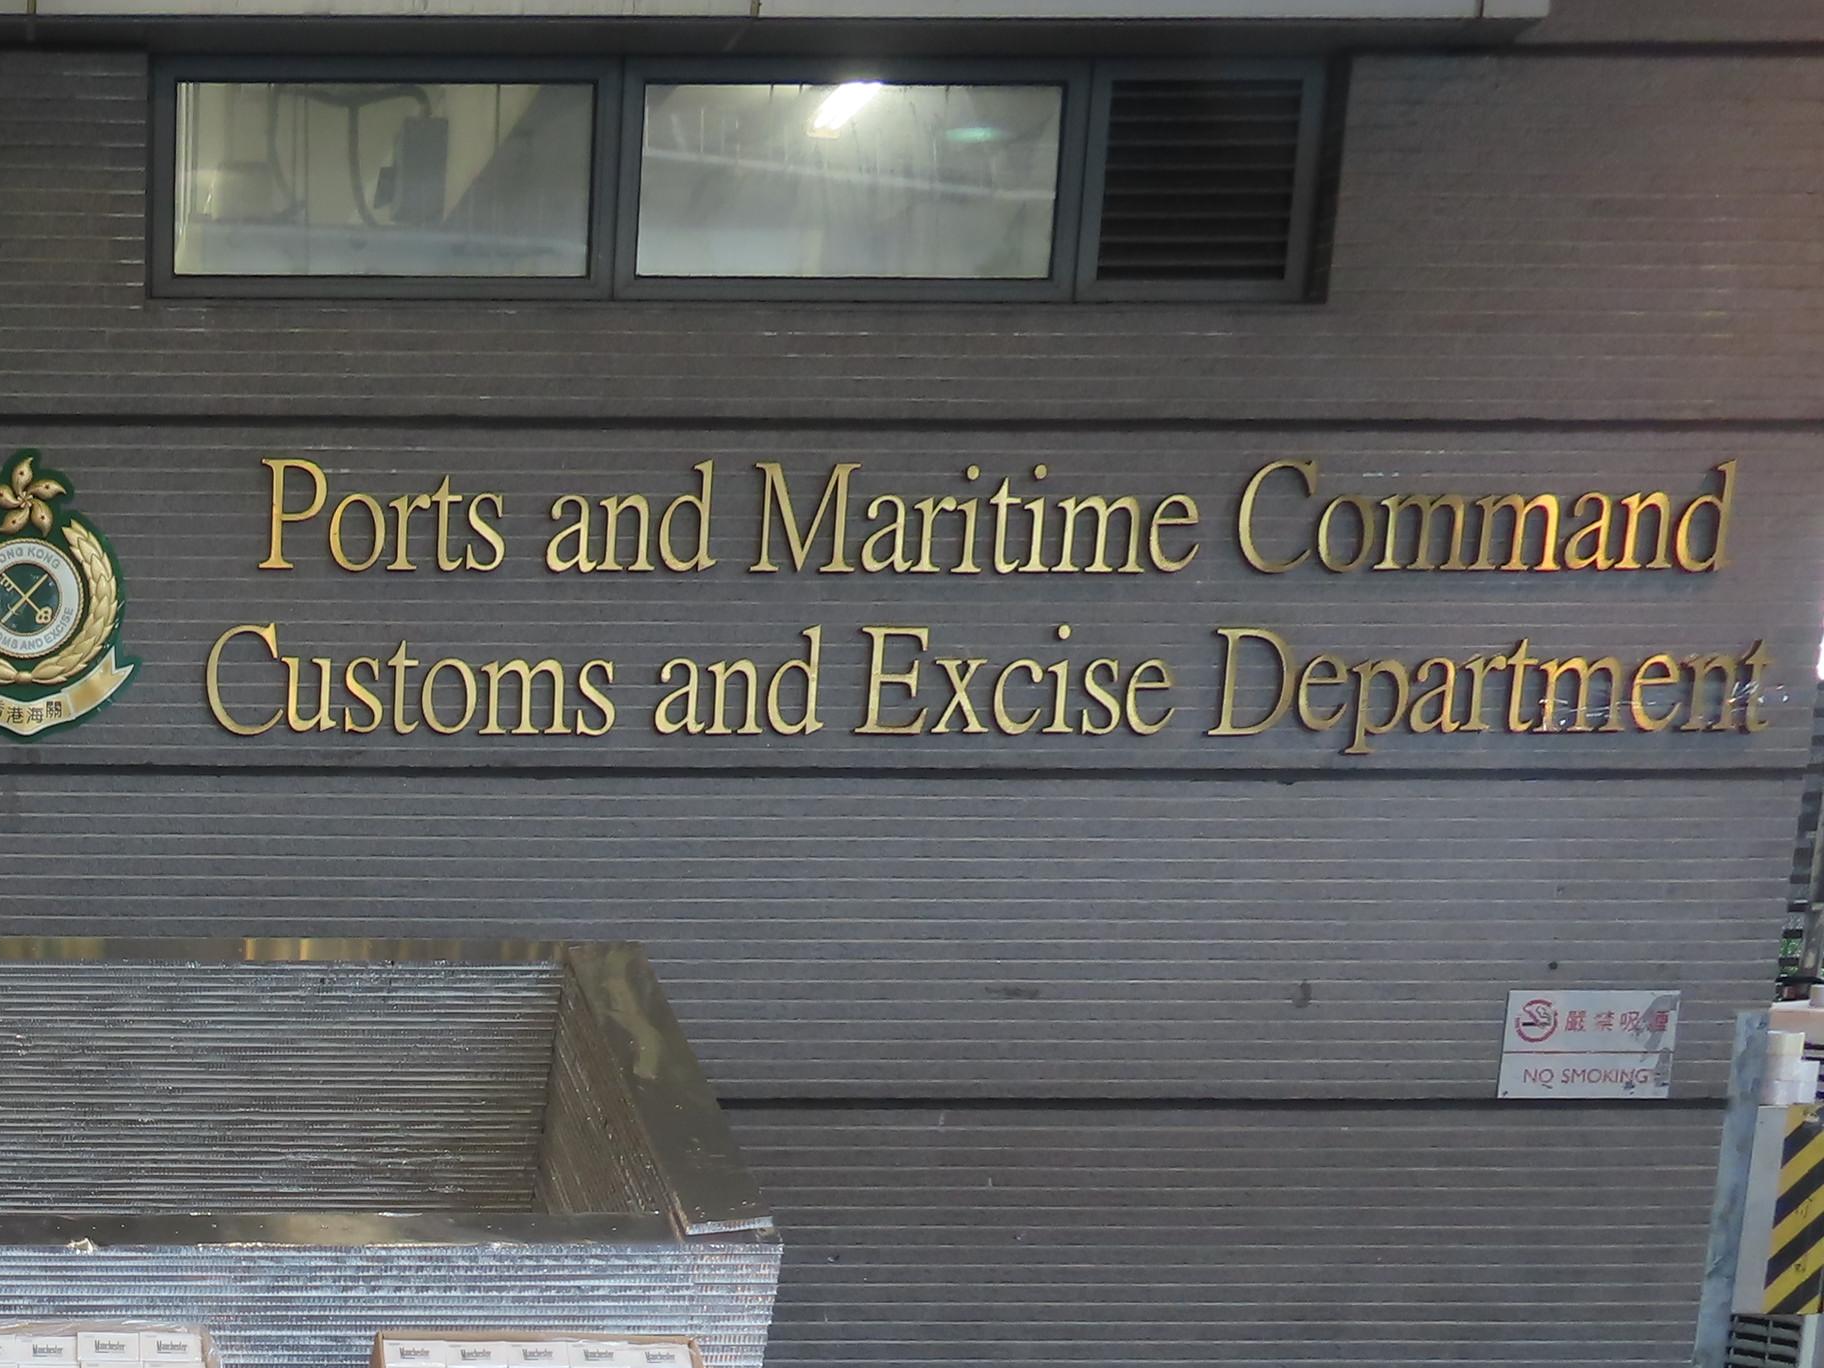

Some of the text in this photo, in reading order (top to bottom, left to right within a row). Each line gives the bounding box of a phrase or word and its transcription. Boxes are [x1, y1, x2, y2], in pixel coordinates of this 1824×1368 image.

[257, 458, 1738, 575] Ports and Maritime Command
[27, 547, 60, 570] KONG
[19, 638, 45, 650] AND
[44, 606, 74, 644] EXCISE
[205, 622, 1772, 756] Customs and Excise Department
[1523, 1068, 1651, 1085] NO SMOKING
